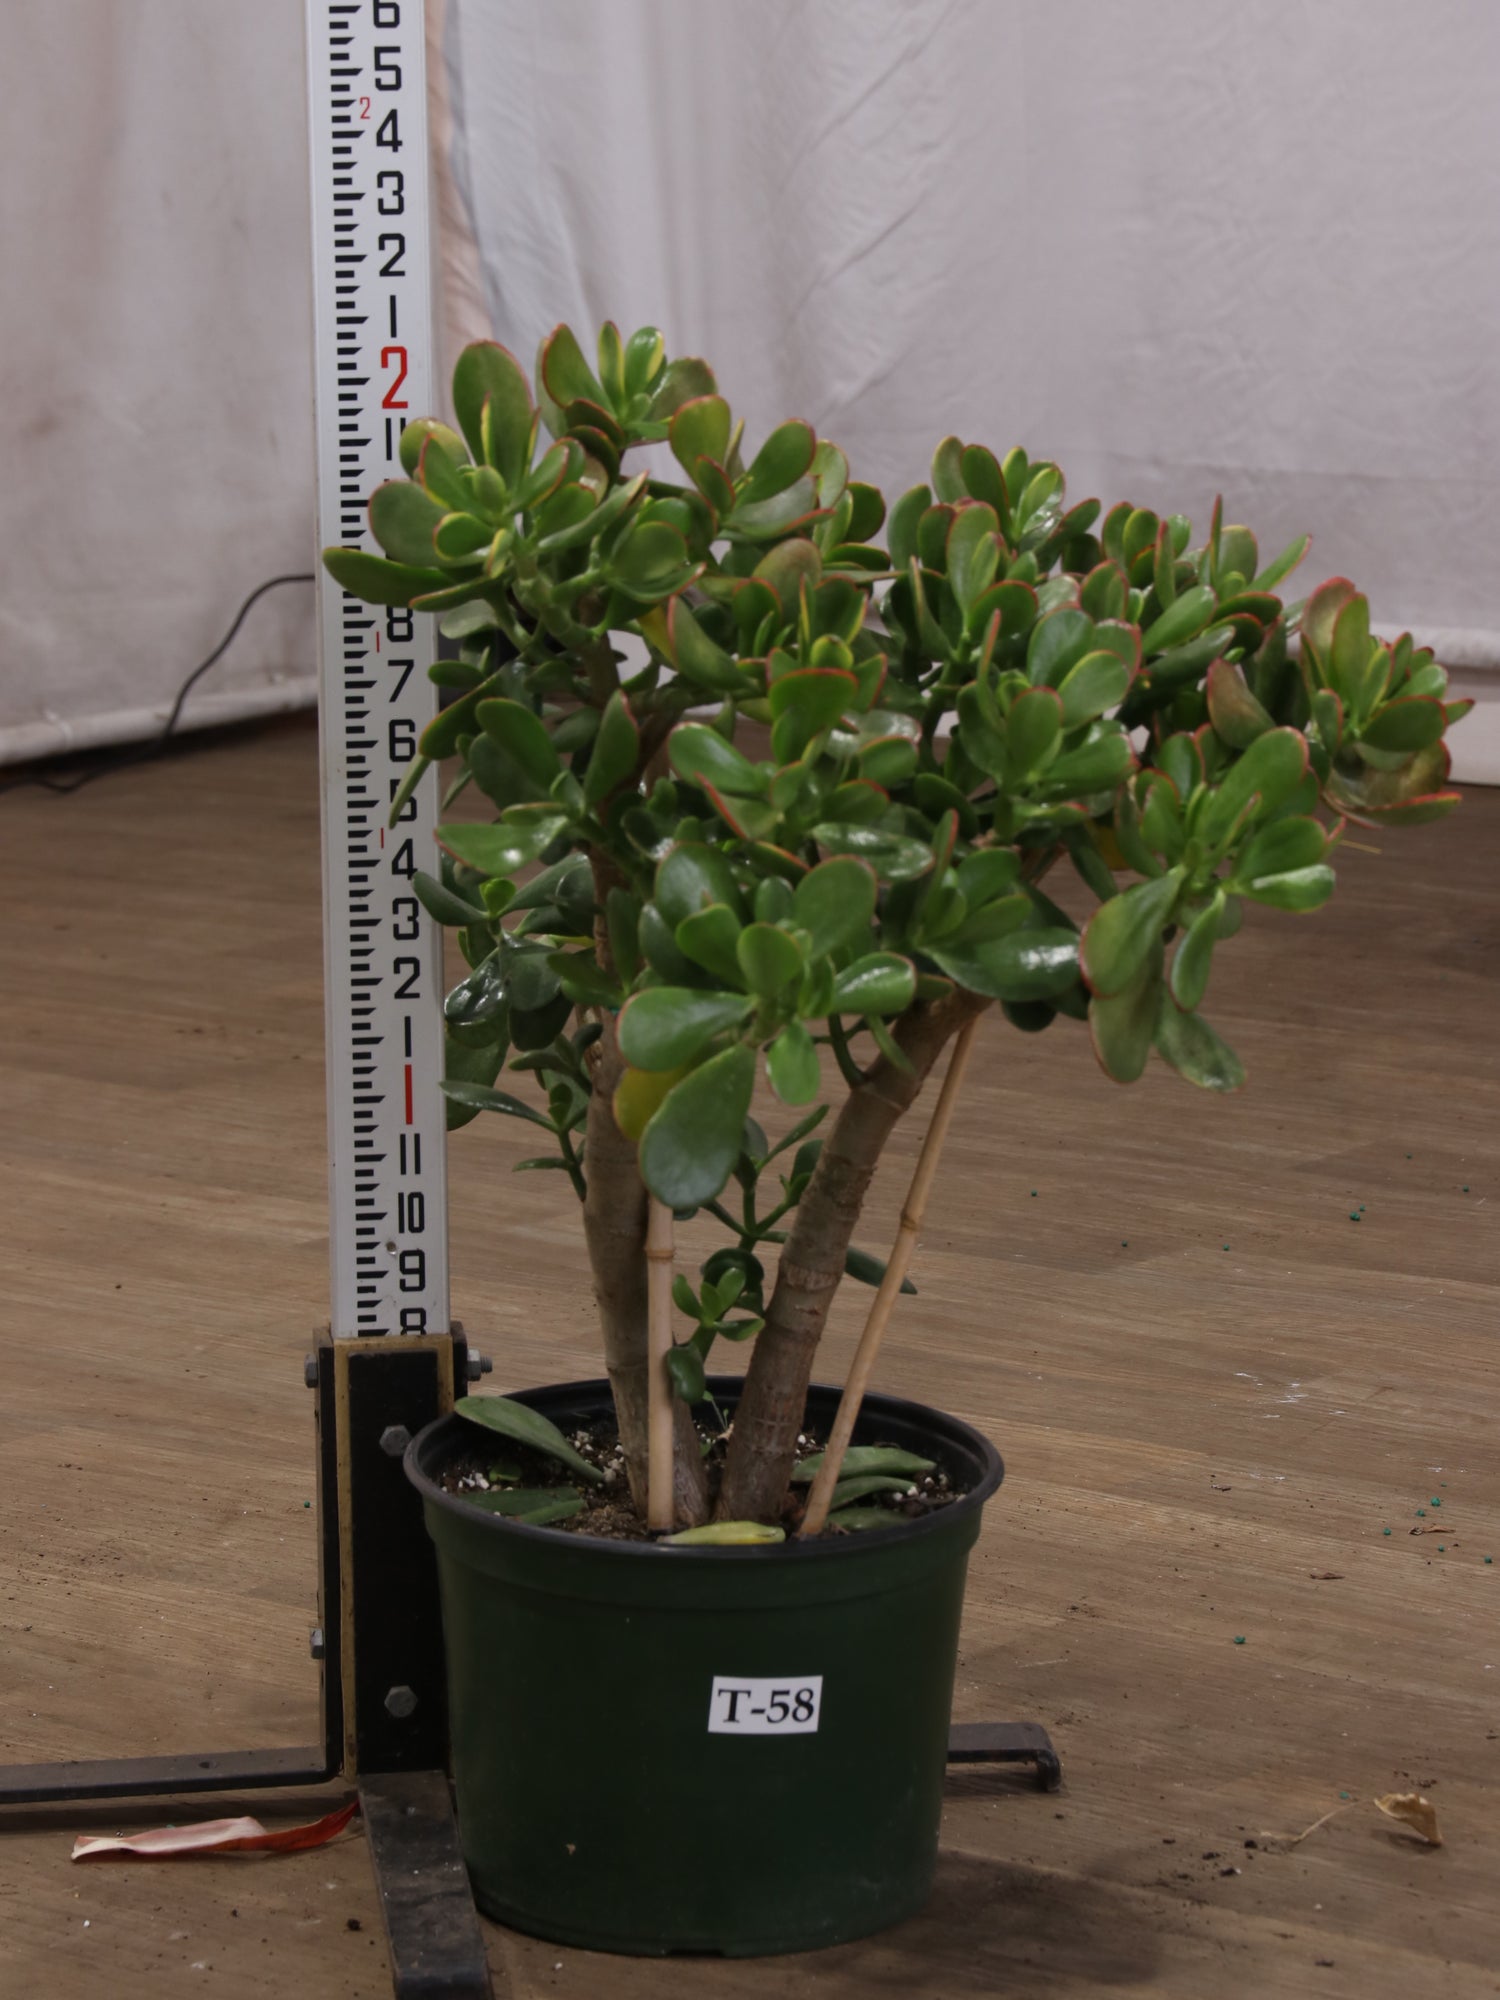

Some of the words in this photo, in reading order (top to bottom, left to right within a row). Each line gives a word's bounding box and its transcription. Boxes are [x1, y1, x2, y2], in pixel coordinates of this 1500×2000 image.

[373, 0, 400, 28] 6
[374, 46, 402, 91] 5
[359, 97, 371, 119] 2
[376, 109, 403, 152] 4
[377, 171, 404, 215] 3
[378, 233, 405, 277] 2
[389, 295, 397, 338] 1
[381, 346, 408, 409] 2
[386, 606, 413, 642] 8
[388, 659, 415, 702] 7
[389, 719, 416, 762] 6
[391, 838, 418, 880] 4
[392, 897, 419, 940] 3
[393, 957, 420, 999] 2
[404, 1016, 412, 1057] 1
[405, 1064, 413, 1125] 1
[400, 1133, 421, 1175] 11
[398, 1192, 425, 1233] 10
[400, 1250, 426, 1292] 9
[400, 1308, 427, 1335] 8
[718, 1688, 815, 1724] T-58
